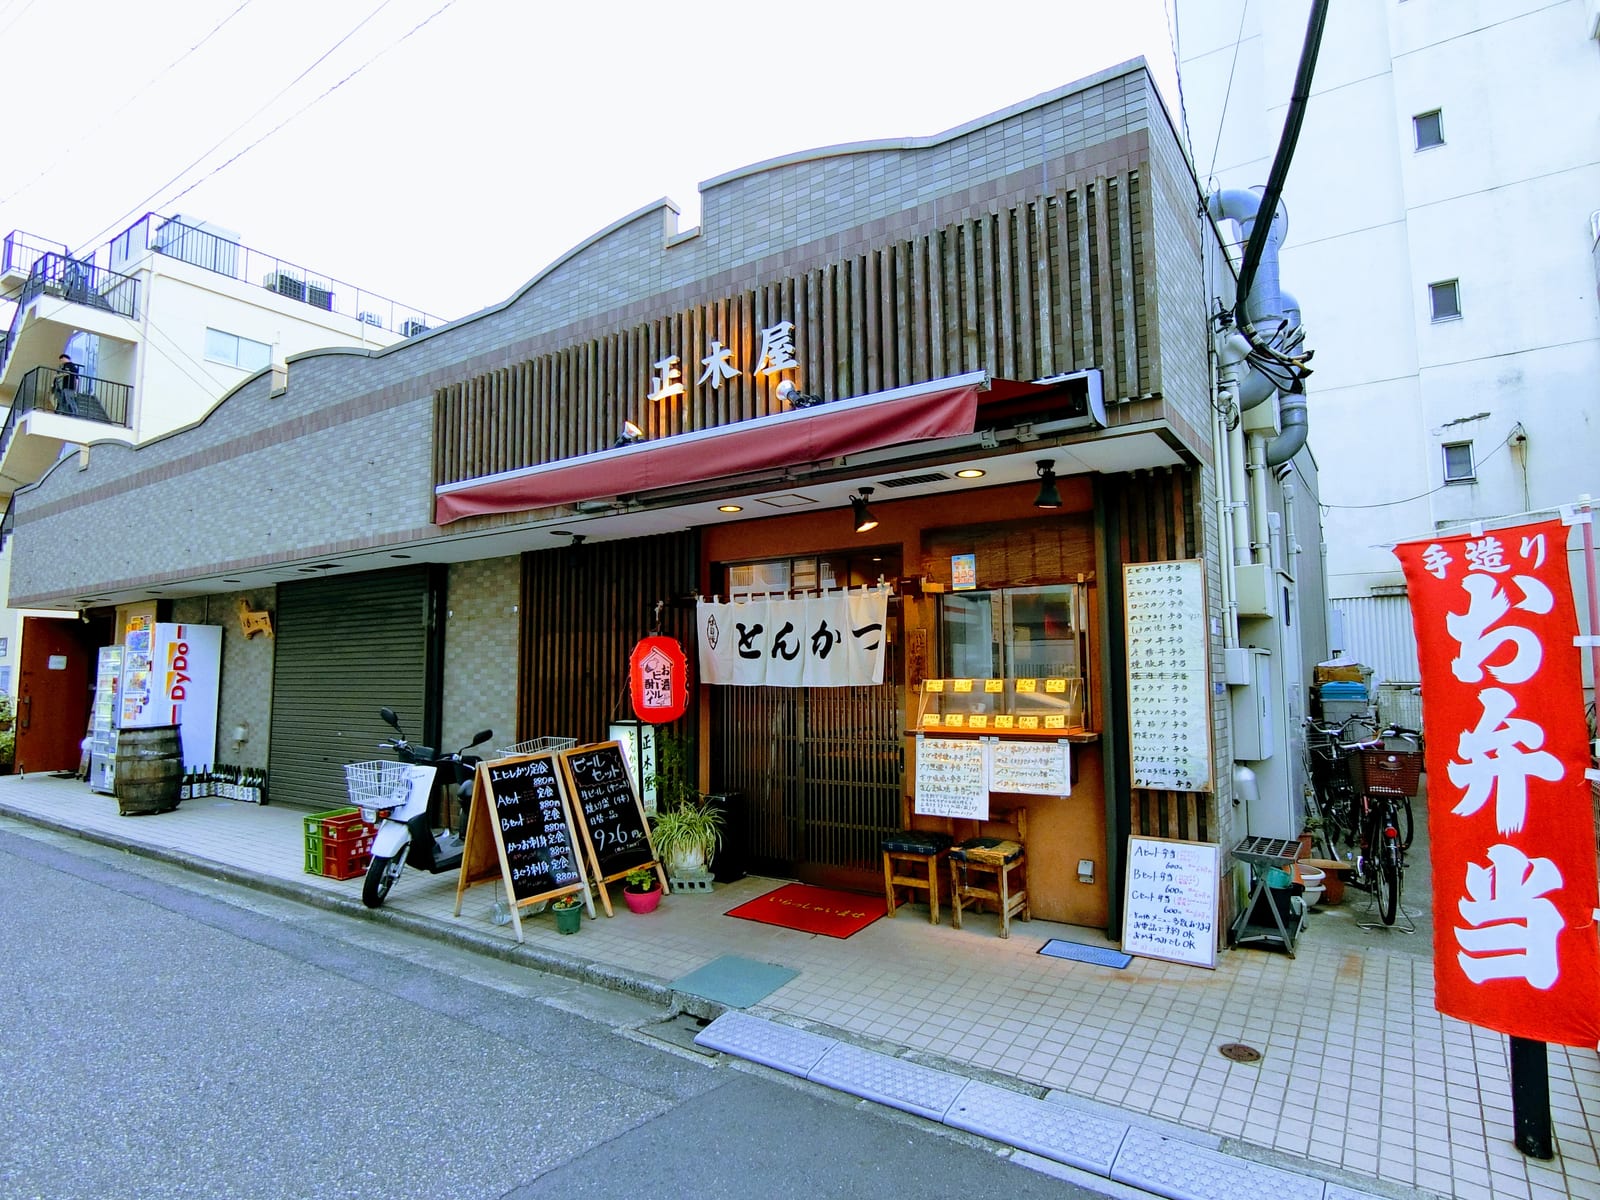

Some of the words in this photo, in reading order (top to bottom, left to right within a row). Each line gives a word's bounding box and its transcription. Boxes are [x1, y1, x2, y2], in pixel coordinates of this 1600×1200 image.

[647, 321, 800, 402] 正木屋
[1421, 533, 1546, 580] 手造り
[170, 642, 192, 701] DyDo
[652, 670, 663, 699] ビール
[661, 664, 670, 691] お酒
[644, 678, 655, 705] 酎ハイ
[572, 753, 606, 773] ビール
[592, 763, 620, 782] セット
[642, 734, 654, 792] 正木屋
[1446, 573, 1566, 990] お弁当
